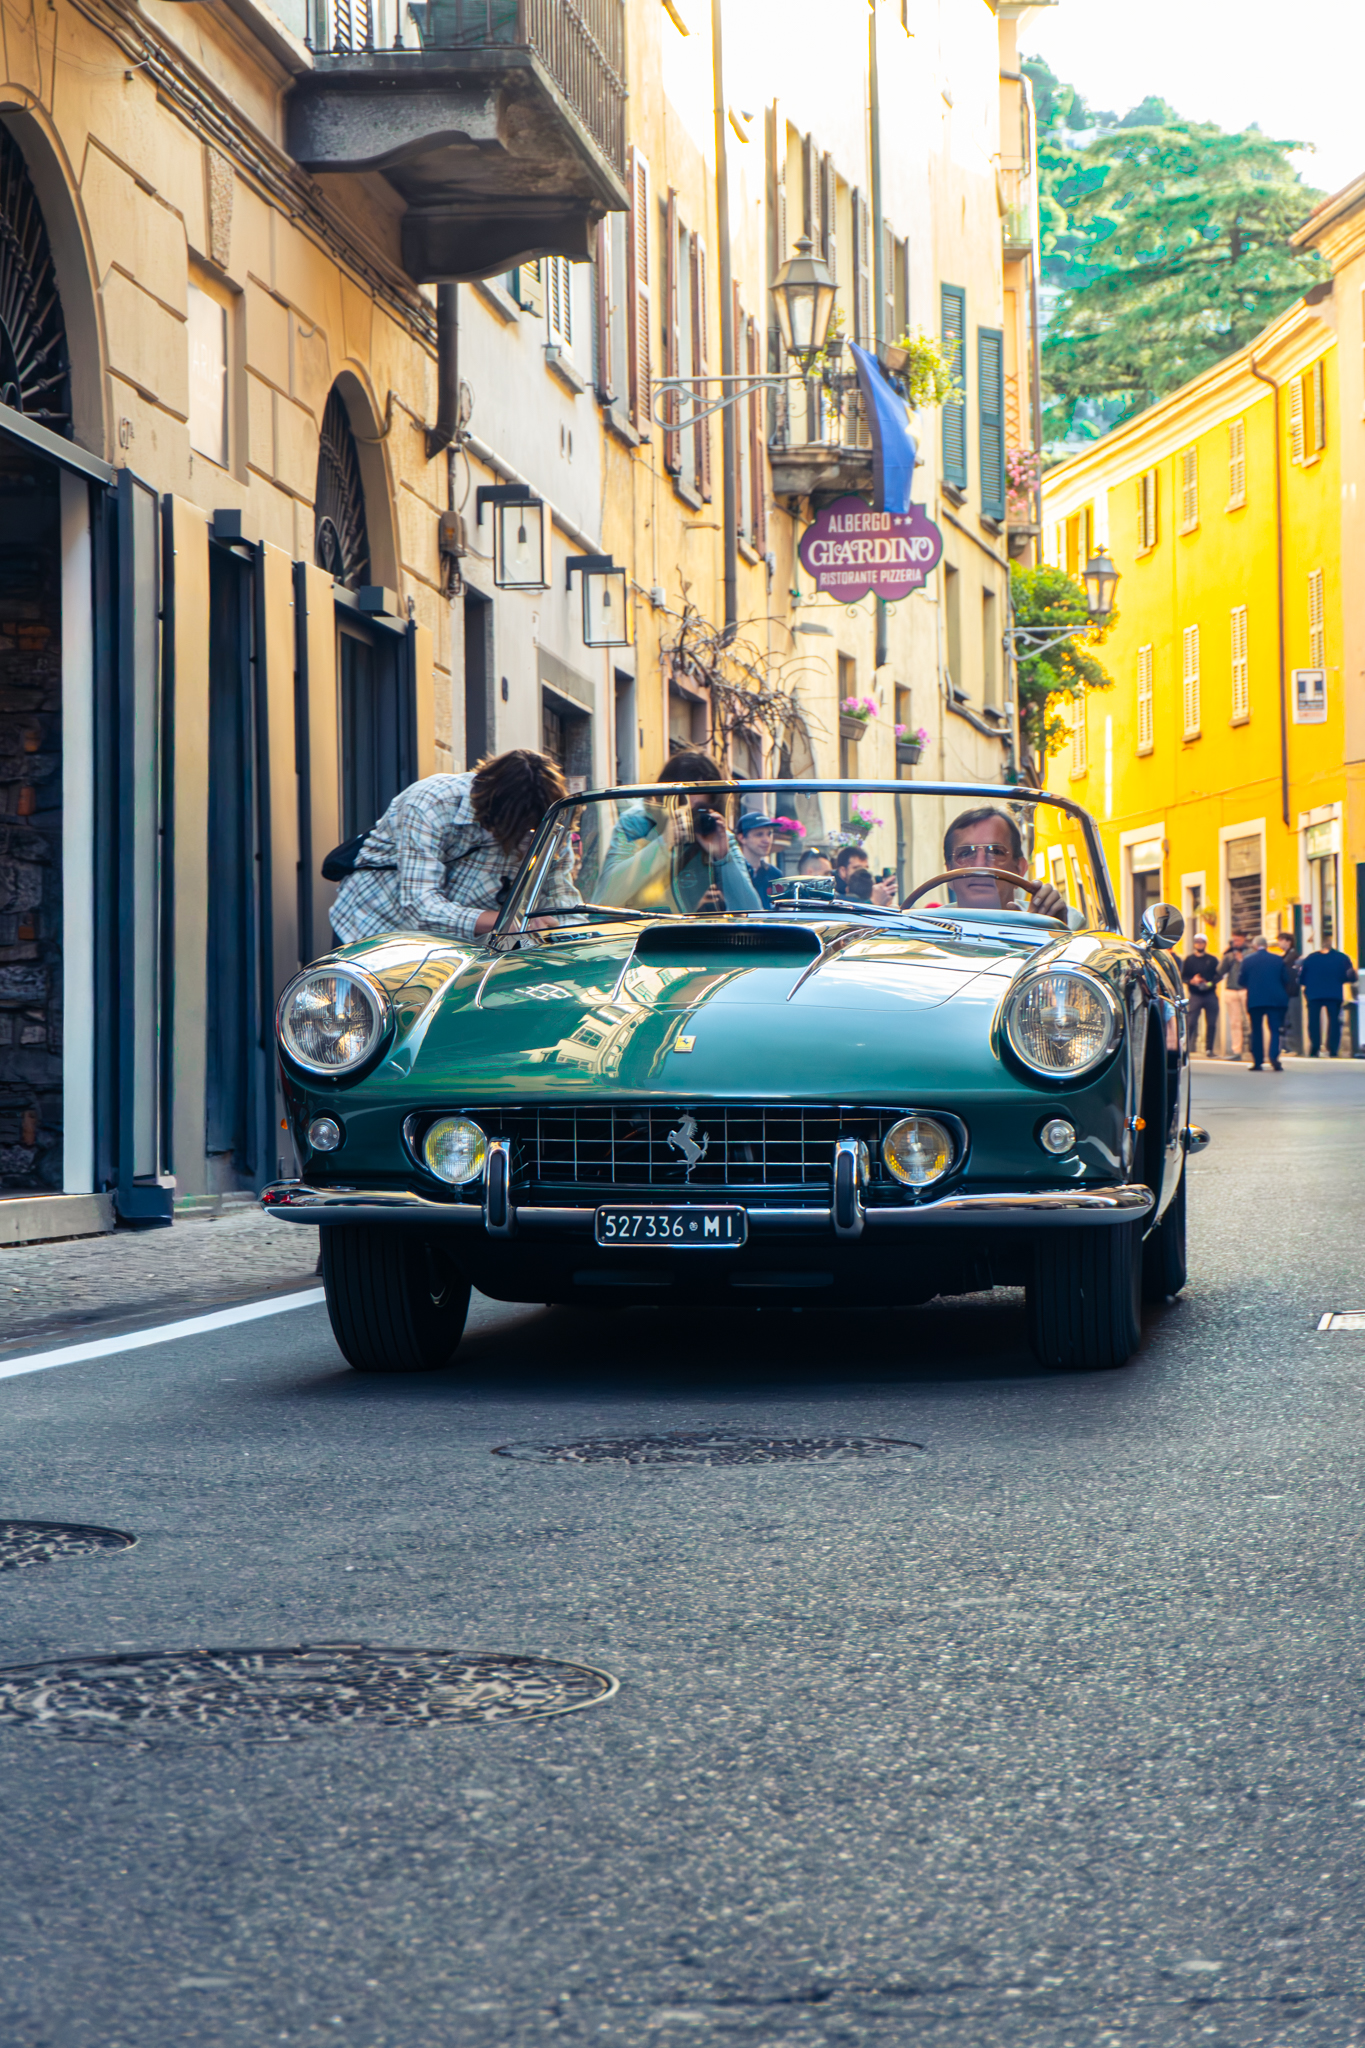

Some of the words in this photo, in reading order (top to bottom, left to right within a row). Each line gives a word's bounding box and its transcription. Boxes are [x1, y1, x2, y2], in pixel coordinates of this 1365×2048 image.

[828, 512, 891, 533] ALBERGO
[808, 536, 935, 566] GIARDINO
[820, 569, 877, 586] RISTORANTE
[880, 568, 922, 583] PIZZERIA
[605, 1215, 684, 1237] 527336
[704, 1215, 732, 1237] MI
